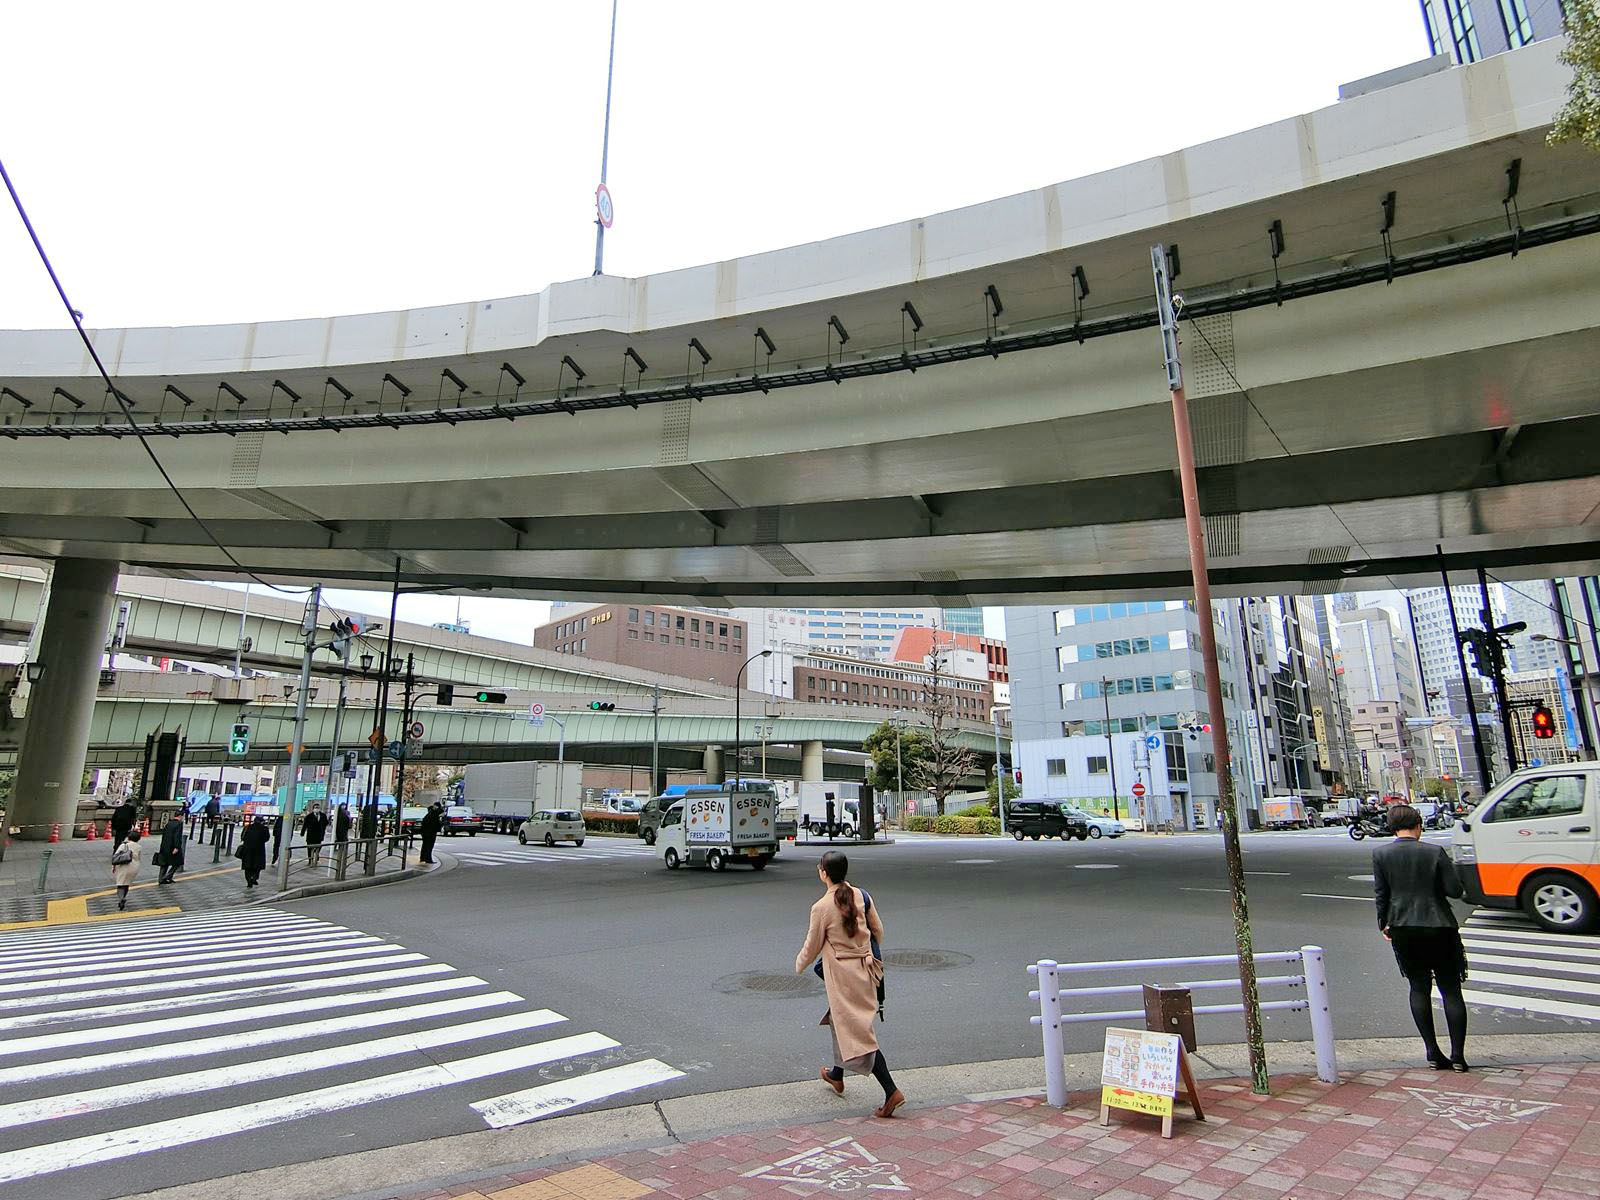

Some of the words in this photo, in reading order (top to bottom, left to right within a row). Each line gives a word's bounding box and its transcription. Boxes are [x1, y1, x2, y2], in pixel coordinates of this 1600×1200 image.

[691, 800, 725, 815] ESSEN
[737, 797, 771, 810] ESSEN
[706, 831, 725, 839] BAKERY
[1140, 1079, 1174, 1092] 手作り弁当
